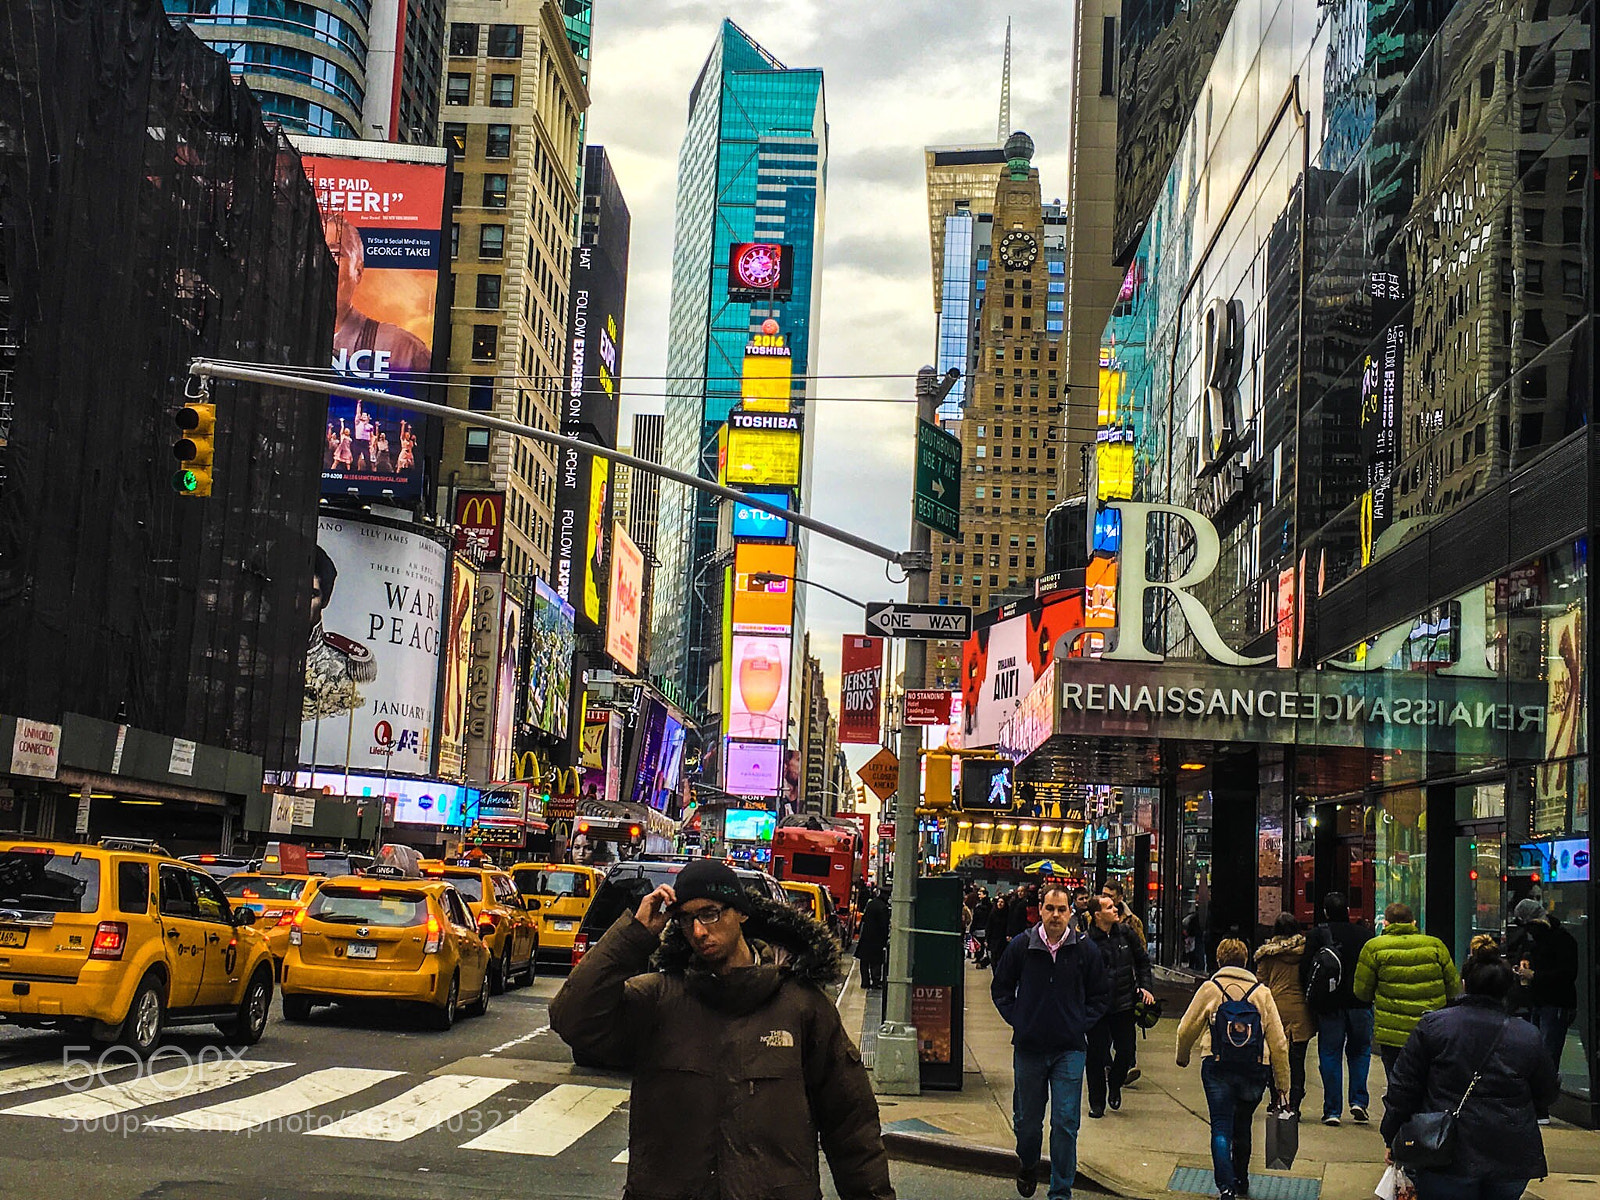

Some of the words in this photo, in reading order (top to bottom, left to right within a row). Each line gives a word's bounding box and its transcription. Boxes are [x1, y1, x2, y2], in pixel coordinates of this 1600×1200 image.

[319, 178, 335, 190] BE
[338, 178, 373, 191] PAID.
[366, 247, 403, 256] GEORGE
[404, 247, 431, 257] TAKEI
[575, 290, 589, 338] FOLLOW
[753, 334, 784, 347] 2016
[745, 345, 791, 356] TOSHIBA
[570, 339, 585, 398] EXPRESS
[569, 399, 582, 417] ON
[733, 415, 798, 429] TOSHIBA
[920, 425, 961, 463] SOUTHBOUND
[923, 449, 936, 470] USE
[938, 457, 942, 473] 7
[944, 461, 956, 481] AVE
[918, 498, 935, 520] BEST
[936, 507, 957, 531] ROUTE
[361, 528, 381, 541] LILY
[383, 533, 409, 545] JAMES
[463, 527, 494, 535] OPEN
[559, 509, 575, 558] FOLLOW
[370, 562, 401, 575] THREE
[384, 581, 434, 621] WAR
[880, 614, 912, 628] ONE
[929, 615, 963, 630] WAY
[366, 613, 440, 657] PEACE
[469, 586, 495, 738] PALACE
[842, 669, 882, 691] JERSEY
[993, 669, 1019, 701] ANTI
[845, 690, 874, 711] BOYS
[907, 692, 916, 700] NO
[917, 692, 945, 701] STANDING
[1062, 682, 1299, 719] RENAISSANCE
[373, 699, 425, 719] JANUARY
[907, 707, 924, 715] Loading
[868, 763, 884, 772] LEFT
[884, 764, 898, 772] LAN
[911, 988, 944, 999] OVE
